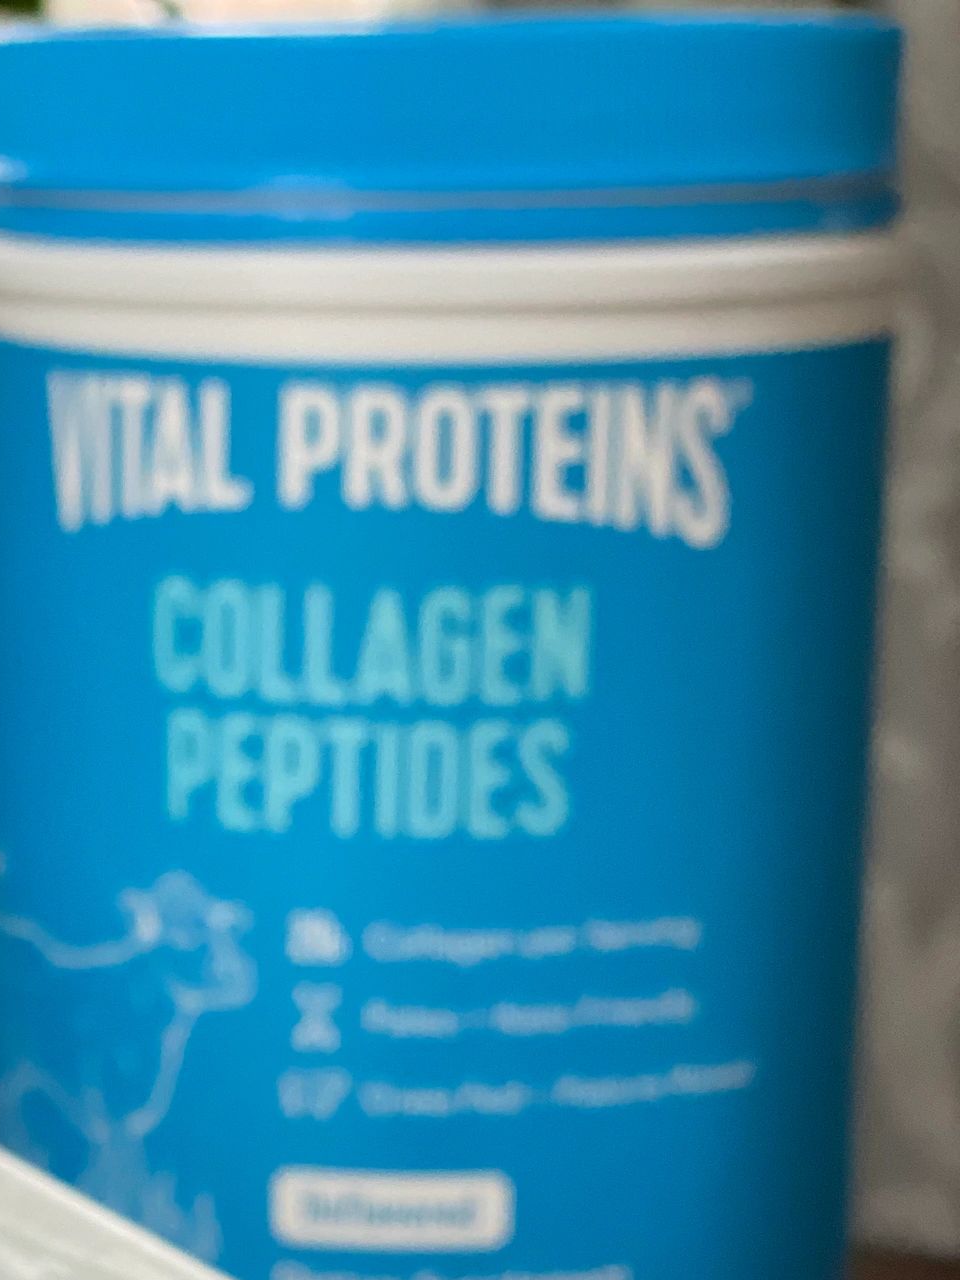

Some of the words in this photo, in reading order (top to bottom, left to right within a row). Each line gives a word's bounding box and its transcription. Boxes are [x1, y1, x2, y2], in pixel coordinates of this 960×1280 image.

[47, 371, 252, 531] VITAL
[276, 376, 734, 549] PROTEINS
[152, 573, 592, 706] COLLAGEN
[166, 707, 570, 839] PEPTIDES
